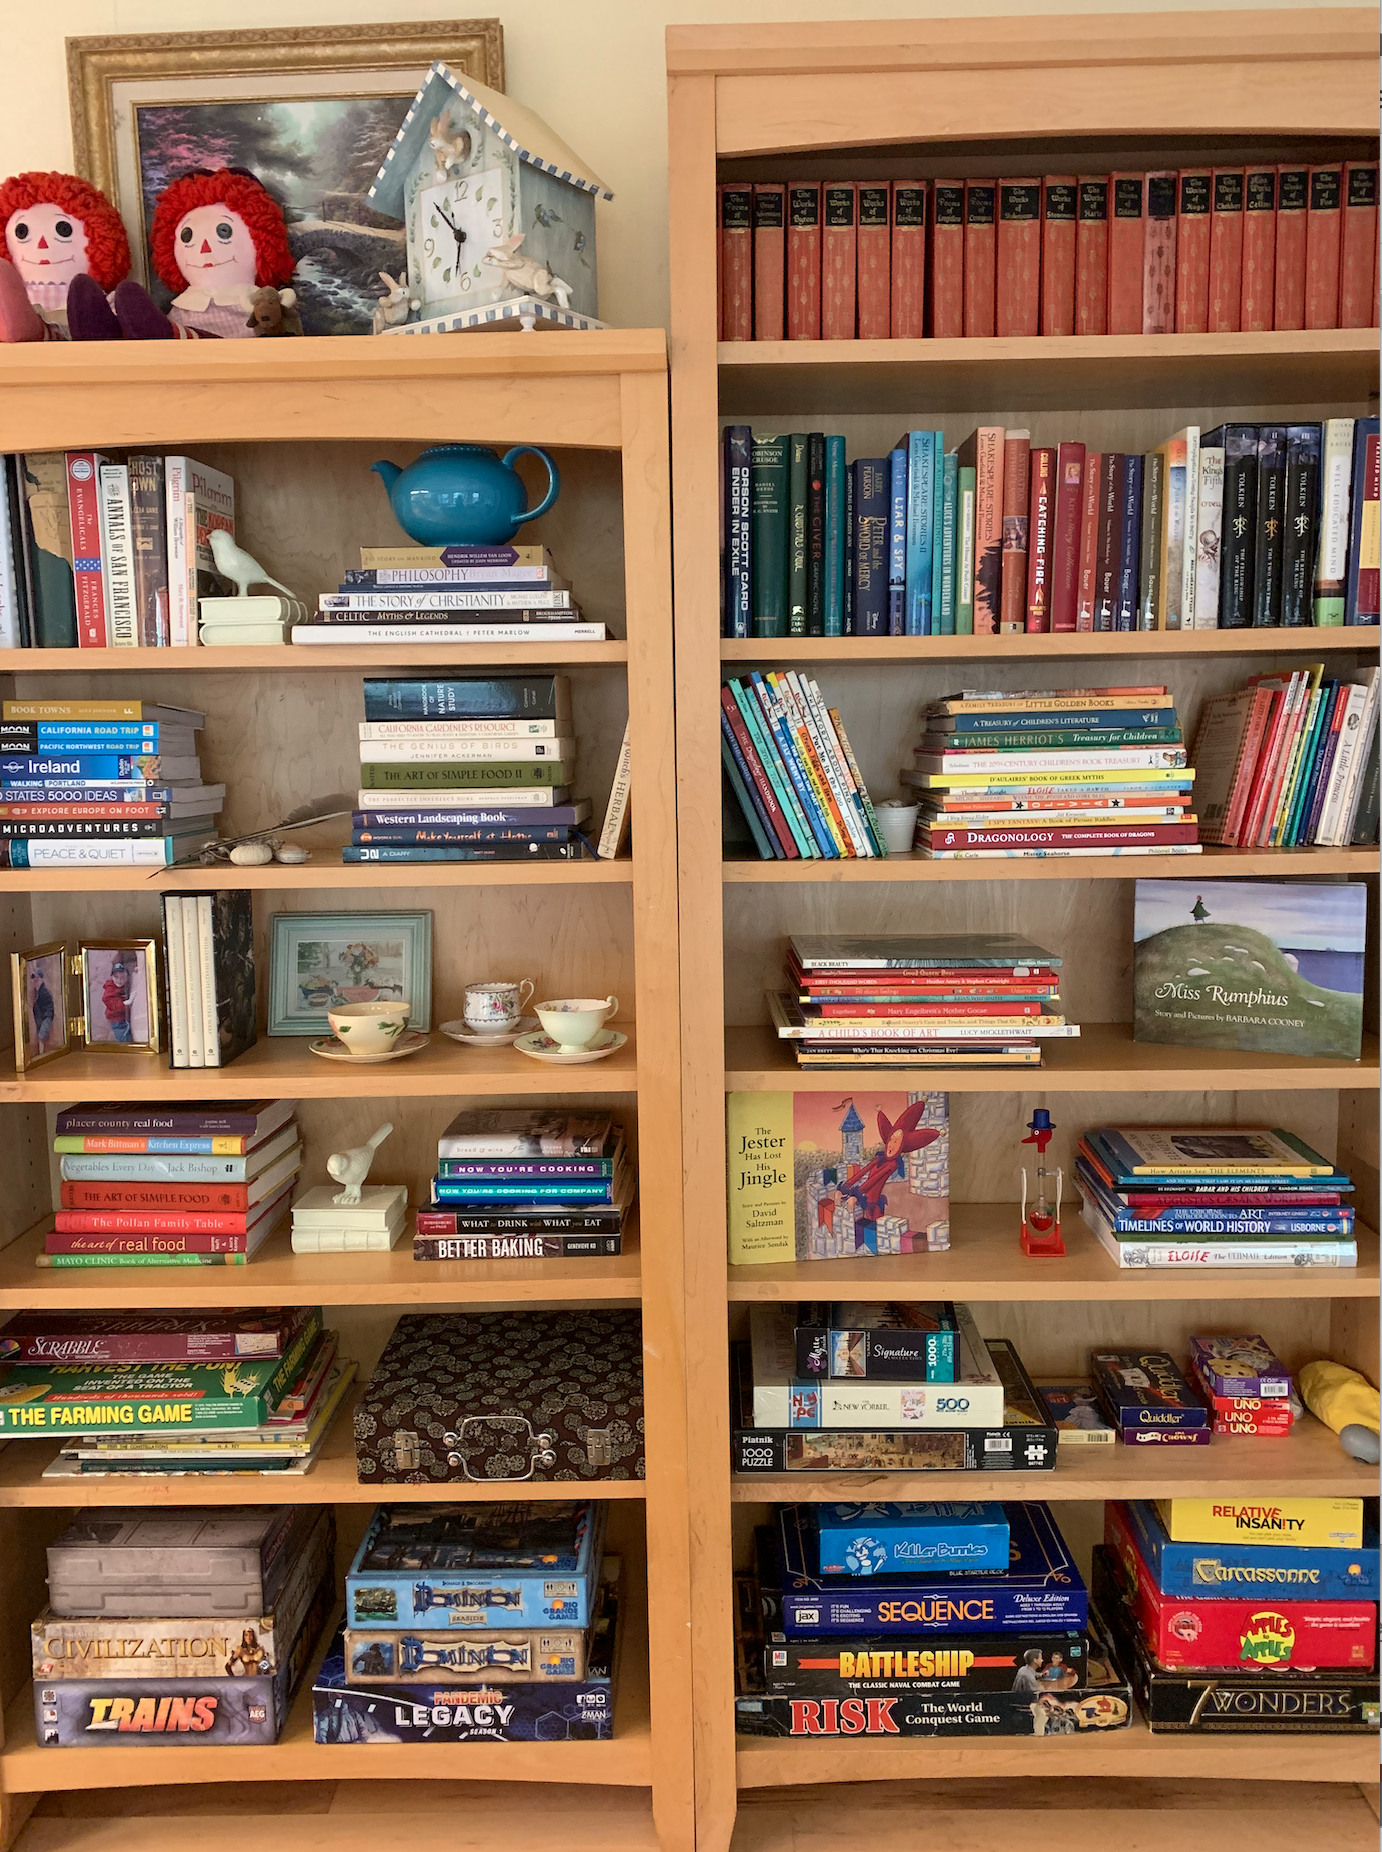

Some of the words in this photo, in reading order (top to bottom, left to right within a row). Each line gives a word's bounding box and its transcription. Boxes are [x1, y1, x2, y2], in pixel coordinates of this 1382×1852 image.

[454, 181, 468, 202] 12
[492, 219, 503, 238] 3
[424, 239, 435, 258] 9
[460, 271, 471, 291] 6
[741, 467, 749, 518] ORSON
[1238, 473, 1246, 508] TOLKIEN
[75, 488, 86, 550] EVANGELICALS
[107, 498, 125, 541] ANNALS
[1037, 497, 1046, 554] CATCHING
[732, 520, 739, 535] IN
[111, 555, 128, 576] SAN
[391, 569, 468, 582] PHILOSOPHY
[82, 576, 90, 626] FITZGERALD
[90, 579, 98, 619] FRANCES
[355, 596, 376, 607] THE
[379, 596, 413, 607] STORY
[415, 594, 425, 607] of
[430, 595, 505, 607] CHRISTIANITY
[113, 582, 132, 639] FRANCISCO
[964, 736, 999, 746] JAMES
[1004, 734, 1064, 746] HERRIOT'S
[1073, 734, 1106, 742] Treasury
[1109, 733, 1121, 742] for
[1123, 732, 1157, 740] Children
[29, 760, 80, 773] Ireland
[6, 790, 44, 800] STATES
[48, 790, 82, 800] 5000
[85, 790, 117, 800] IDEAS
[376, 815, 414, 824] Western
[418, 813, 478, 825] Landscaping
[480, 812, 506, 822] Book
[3, 823, 138, 833] MICROADVENTURES
[968, 832, 1053, 842] DRAGONOLOGY
[1155, 983, 1200, 1000] Miss
[1206, 985, 1288, 1007] Rumphius
[1155, 1010, 1172, 1018] Story
[1188, 1012, 1215, 1020] Pictures
[1216, 1014, 1225, 1022] by
[1226, 1014, 1266, 1025] BARBARA
[1268, 1018, 1305, 1027] COONEY
[828, 1029, 867, 1038] CHILD'S
[871, 1029, 899, 1038] BOOK
[902, 1029, 916, 1037] OF
[919, 1029, 939, 1037] ART
[66, 1120, 96, 1129] placer
[99, 1120, 130, 1129] county
[134, 1119, 150, 1127] real
[153, 1119, 173, 1127] food
[755, 1127, 771, 1135] The
[86, 1140, 107, 1148] Mark
[108, 1140, 145, 1148] Bittman's
[148, 1140, 178, 1148] Kitchen
[180, 1141, 210, 1151] Express
[739, 1136, 786, 1154] Jester
[745, 1153, 761, 1161] Has
[764, 1152, 781, 1160] Lost
[738, 1169, 787, 1190] Jingle
[752, 1209, 777, 1217] David
[92, 1218, 112, 1226] The
[117, 1219, 149, 1227] Pollan
[154, 1219, 190, 1230] Family
[195, 1220, 223, 1228] Table
[746, 1219, 783, 1228] Saltzman
[1119, 1220, 1173, 1231] TIMELINES
[1184, 1221, 1224, 1232] WORLD
[1227, 1221, 1271, 1232] HISTORY
[1291, 1223, 1325, 1231] USBORNE
[119, 1238, 148, 1251] real
[152, 1237, 185, 1251] food
[438, 1240, 486, 1258] BETTER
[492, 1238, 543, 1257] BAKING
[28, 1337, 103, 1359] SCRABBLE
[873, 1344, 919, 1358] Signature
[936, 1398, 970, 1410] 500
[1234, 1400, 1260, 1409] UNO
[9, 1408, 45, 1425] THE
[51, 1406, 133, 1424] FARMING
[140, 1405, 192, 1422] GAME
[1139, 1411, 1183, 1424] Quiddler
[742, 1448, 773, 1457] 1000
[742, 1457, 773, 1467] PUZZLE
[1212, 1506, 1282, 1519] RELATIVE
[1236, 1518, 1305, 1530] INSAN!TY
[1193, 1558, 1319, 1584] Carcassonne
[877, 1601, 993, 1621] SEQUENCE
[44, 1637, 228, 1660] CIVILIZATION
[840, 1650, 974, 1678] BATTLESHIP
[434, 1692, 502, 1705] PANDEMIC
[1187, 1681, 1218, 1724] 7
[1210, 1692, 1350, 1714] WONDERS
[87, 1696, 218, 1732] TRAINS
[250, 1709, 265, 1718] AEG
[921, 1703, 944, 1713] The
[947, 1702, 983, 1713] World
[395, 1705, 514, 1727] LEGACY
[790, 1698, 900, 1735] RISK
[906, 1714, 963, 1725] Conquest
[965, 1714, 1000, 1724] Game
